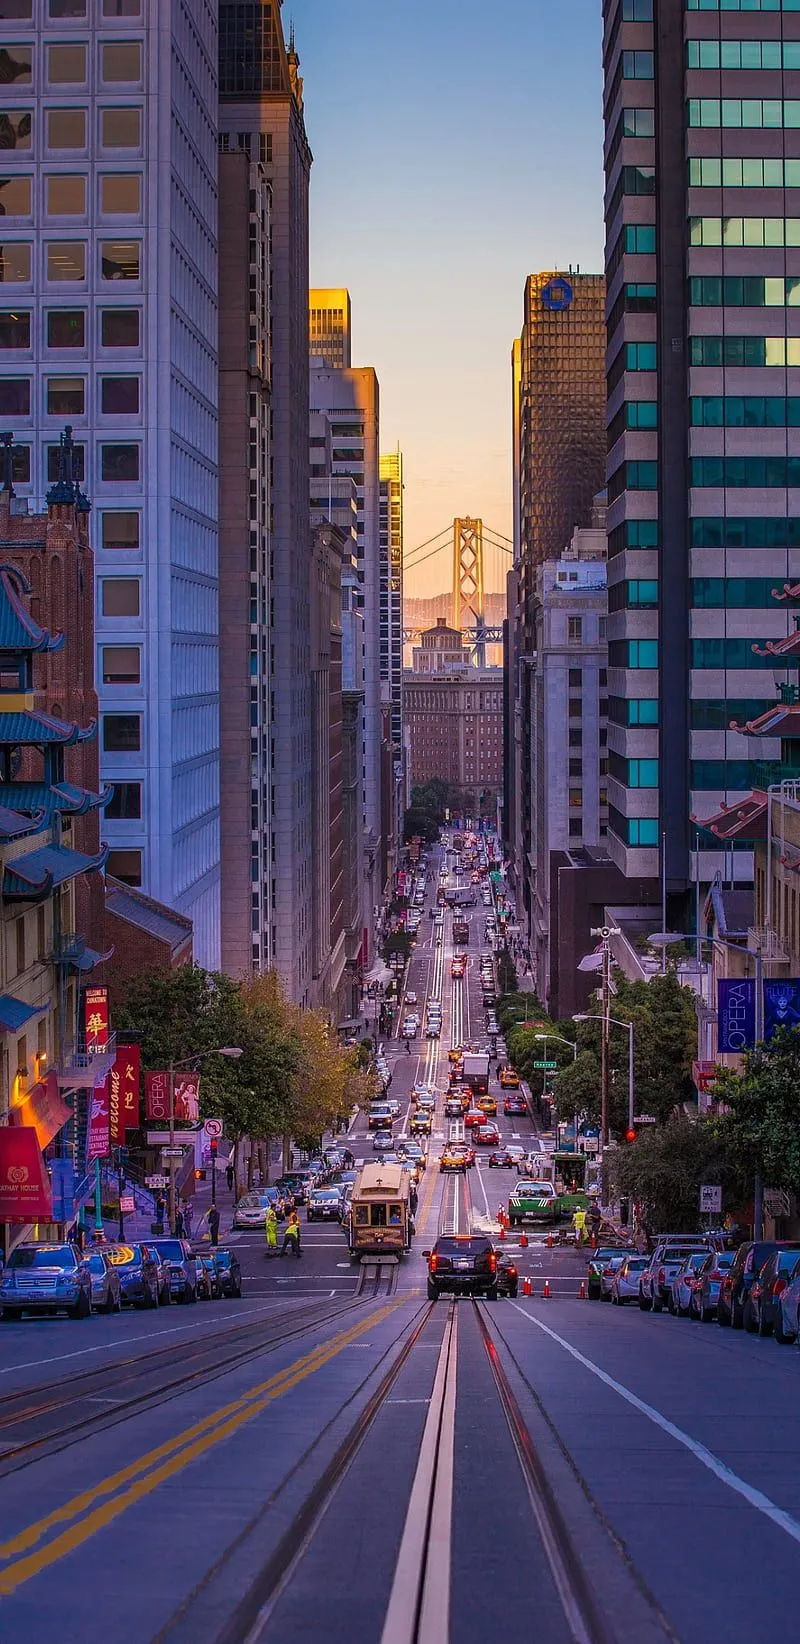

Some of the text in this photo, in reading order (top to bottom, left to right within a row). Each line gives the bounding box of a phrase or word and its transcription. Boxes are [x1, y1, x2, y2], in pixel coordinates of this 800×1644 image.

[728, 983, 746, 1049] OPERA
[110, 1070, 121, 1138] welcome
[152, 1074, 164, 1118] OPERA
[20, 1184, 39, 1192] HOUSE
